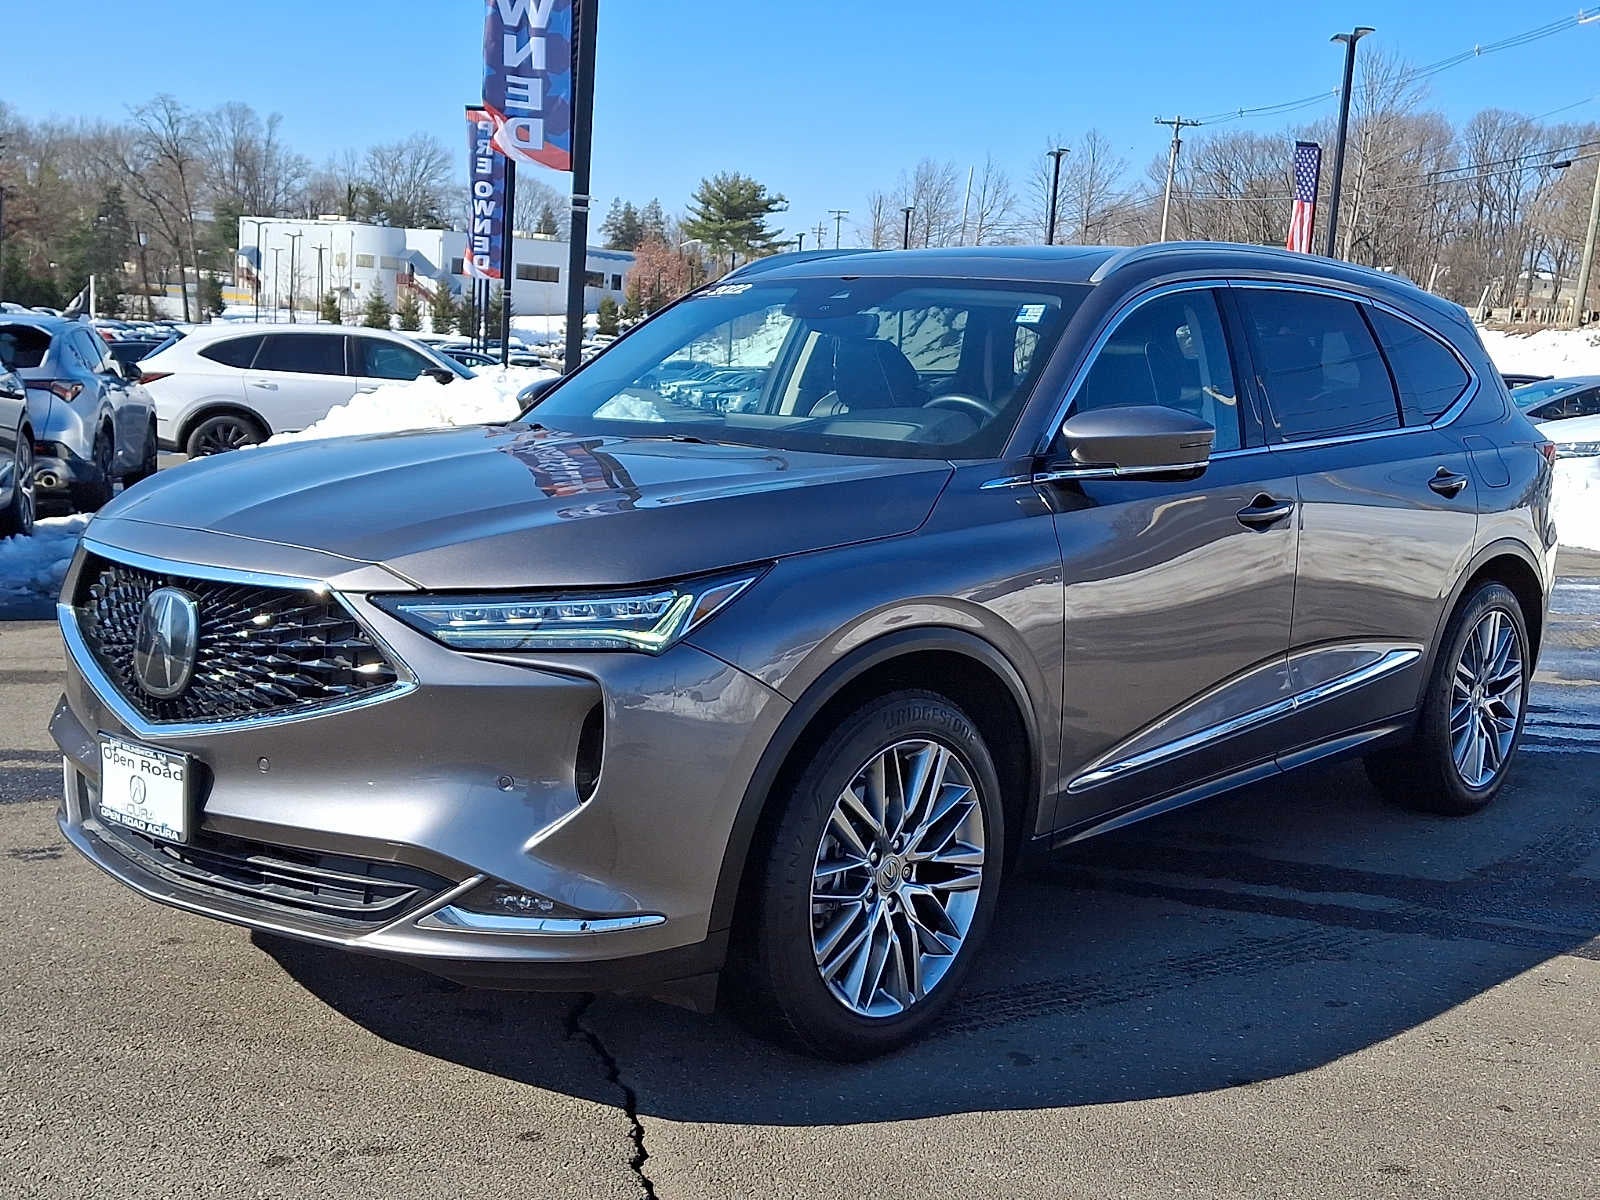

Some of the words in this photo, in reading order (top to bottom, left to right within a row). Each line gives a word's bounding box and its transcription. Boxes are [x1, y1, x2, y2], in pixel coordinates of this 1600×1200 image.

[103, 746, 135, 769] Open
[141, 759, 183, 781] Road
[100, 807, 121, 821] OPEN
[121, 815, 146, 831] ROAD
[146, 824, 179, 840] ACURA
